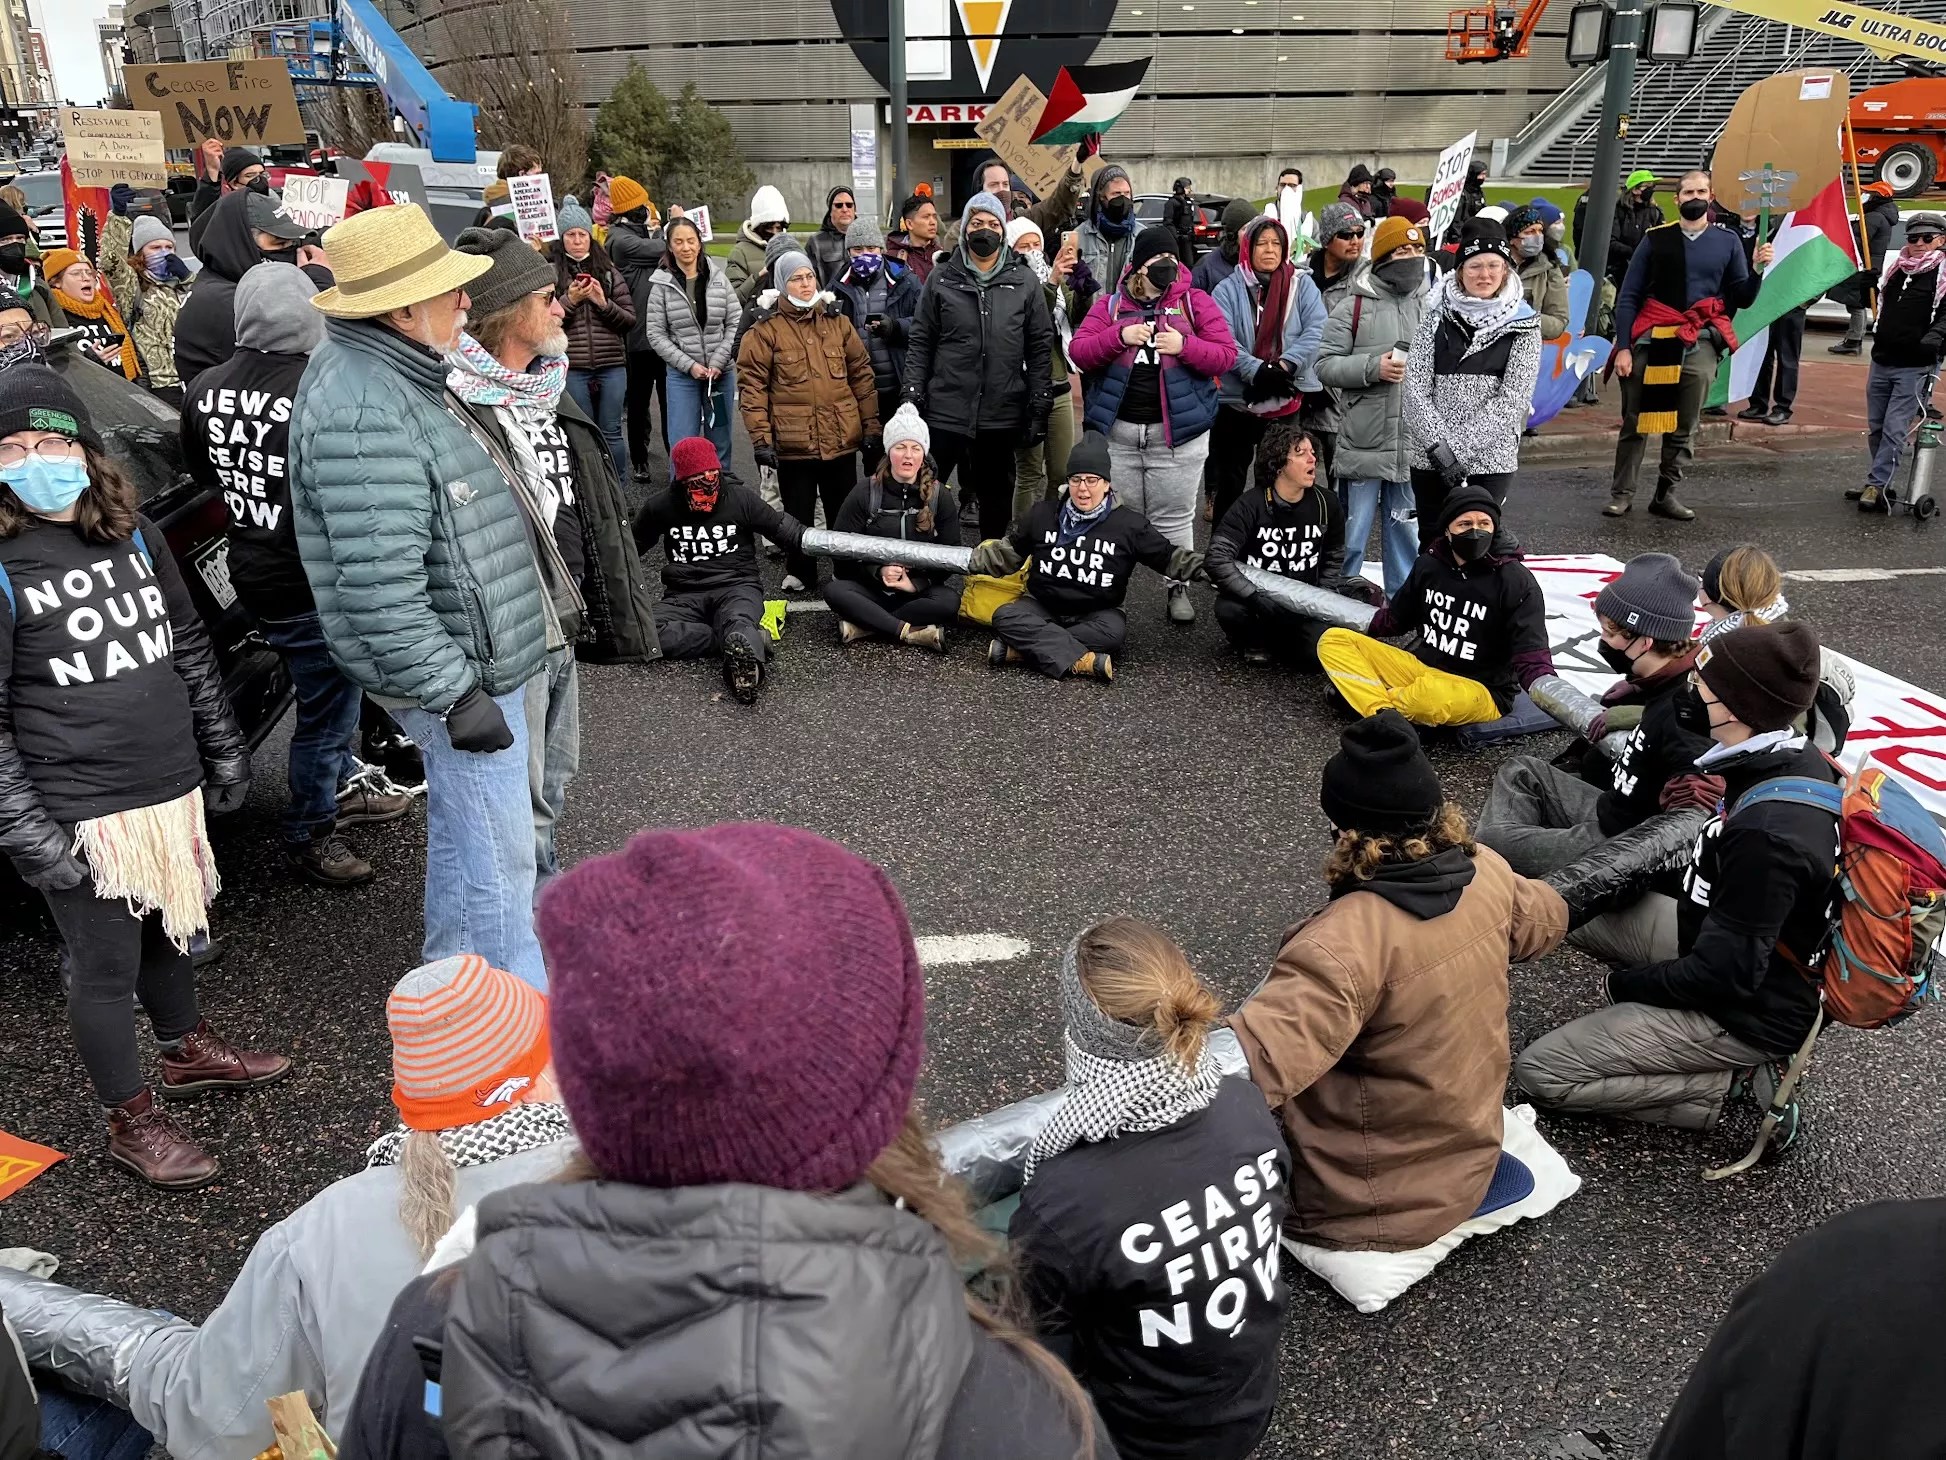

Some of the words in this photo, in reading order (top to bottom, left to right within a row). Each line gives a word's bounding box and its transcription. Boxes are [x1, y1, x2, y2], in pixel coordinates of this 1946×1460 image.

[1818, 10, 1856, 29] JLG
[1860, 19, 1912, 44] ULTRA
[145, 71, 220, 97] Cease
[227, 62, 272, 91] Fire
[175, 98, 273, 144] NOW
[99, 141, 107, 150] A
[77, 169, 103, 179] STOP
[111, 170, 128, 179] THE
[1436, 146, 1471, 183] STOP
[284, 178, 330, 203] STOP
[514, 187, 541, 195] AMERICAN
[1432, 198, 1458, 232] IDS
[198, 388, 293, 422] JEWS
[207, 416, 273, 447] SAY
[669, 524, 737, 540] CEASE
[679, 538, 728, 554] FIRE
[1094, 538, 1116, 556] IN
[1256, 526, 1297, 541] NOT
[1050, 546, 1104, 570] OUR
[1246, 551, 1319, 573] NAME
[1261, 541, 1314, 559] OUR
[23, 558, 116, 615] NOT
[1039, 559, 1114, 587] NAME
[66, 585, 166, 641] OUR
[1425, 588, 1456, 611] NOT
[1462, 600, 1488, 621] IN
[48, 619, 174, 687] NAM
[1120, 1148, 1280, 1264] CEASE
[1165, 1201, 1273, 1296] FIRE
[1138, 1223, 1281, 1348] NOW
